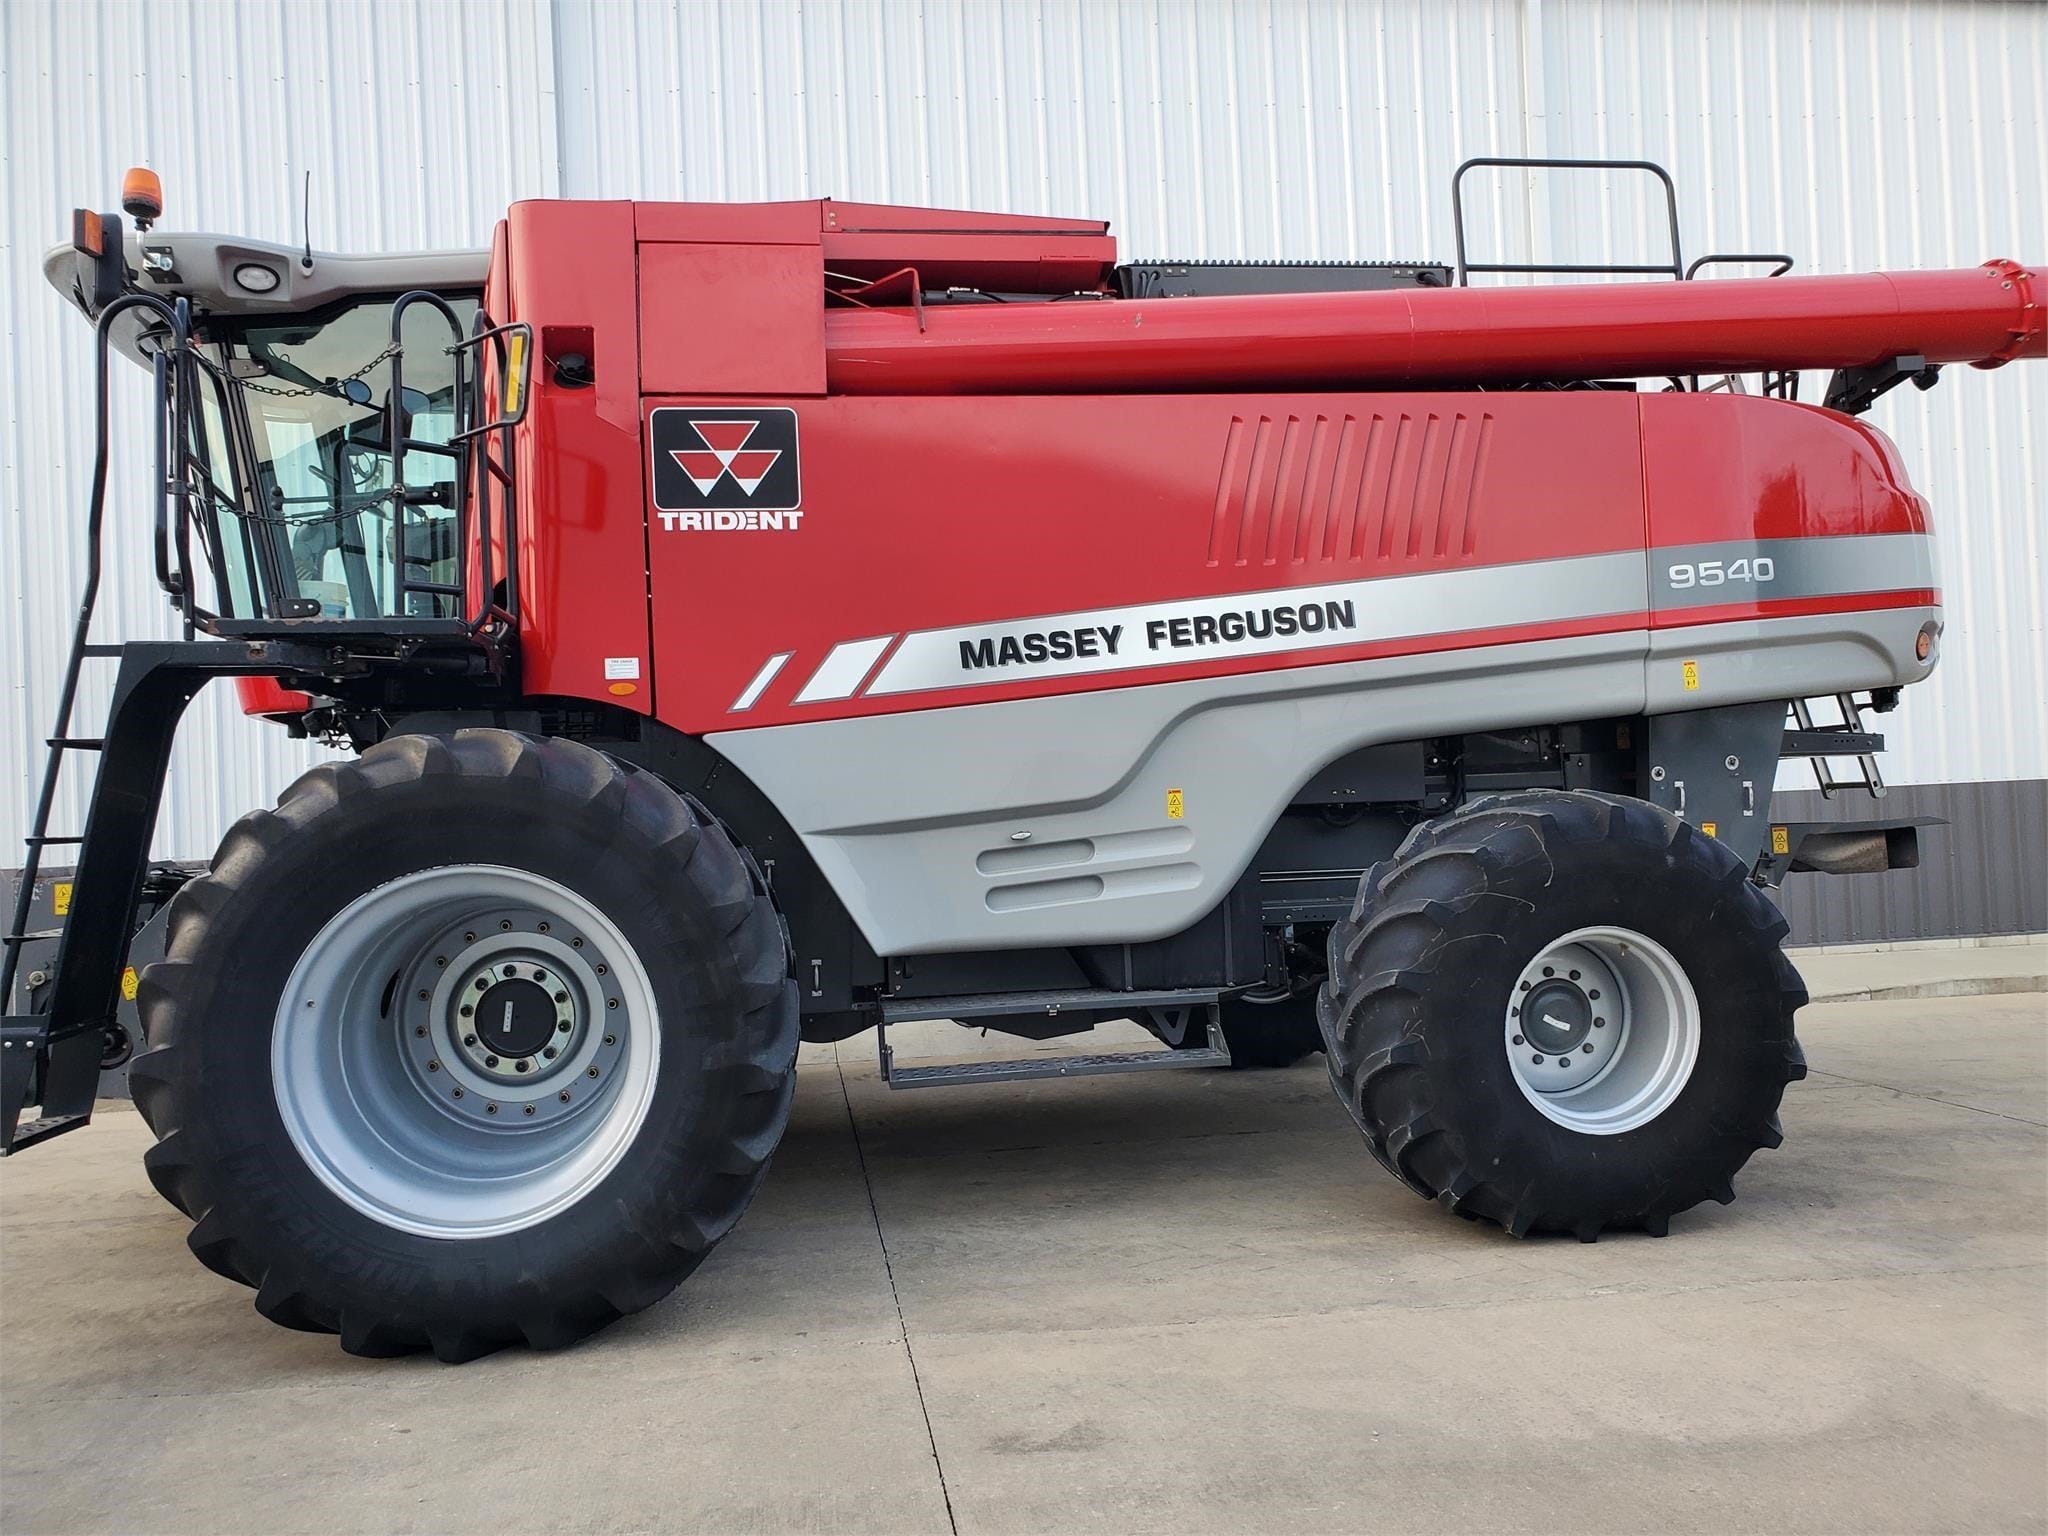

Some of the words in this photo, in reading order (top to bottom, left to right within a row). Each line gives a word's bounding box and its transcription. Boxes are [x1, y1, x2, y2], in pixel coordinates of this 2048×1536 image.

[658, 511, 804, 531] TRIDENT
[1668, 558, 1775, 589] 9540
[958, 624, 1123, 671] MASSEY
[1145, 599, 1357, 652] FERGUSON
